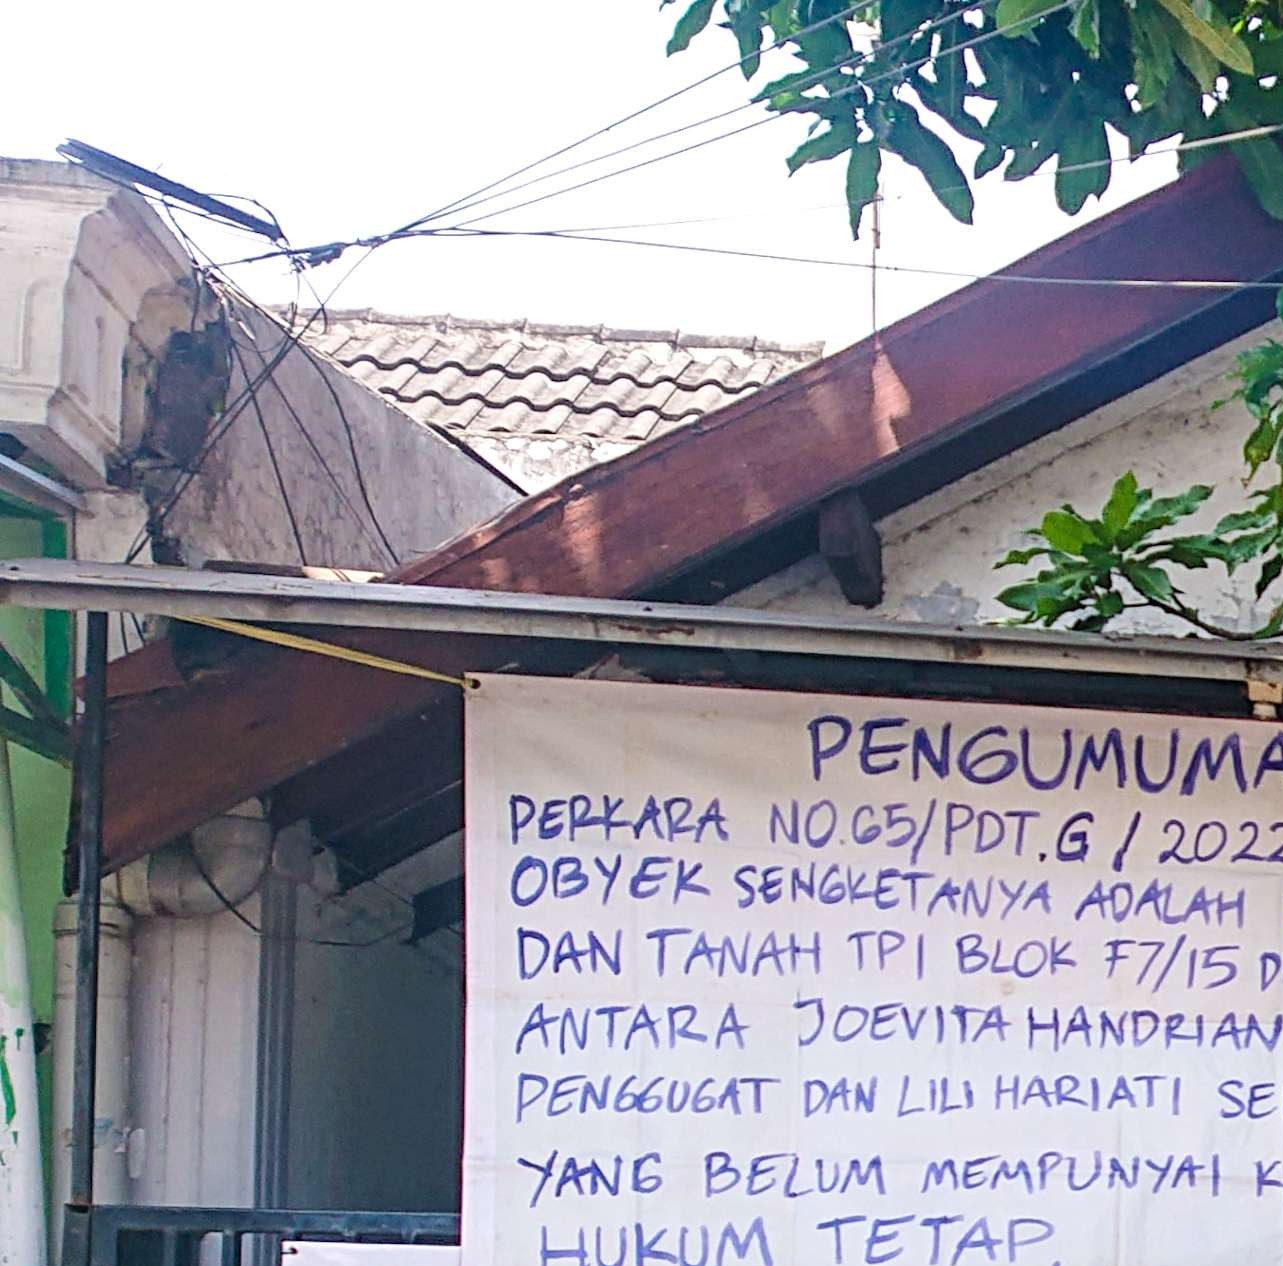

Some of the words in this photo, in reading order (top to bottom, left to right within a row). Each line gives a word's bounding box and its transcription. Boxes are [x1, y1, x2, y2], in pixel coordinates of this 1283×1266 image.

[509, 793, 729, 846] PERKARA
[511, 854, 711, 908] OBYEK
[734, 862, 1053, 919] SENGKETANYA
[1074, 877, 1245, 930] ADALAH
[516, 926, 624, 981] DAN
[646, 926, 821, 978] TANAH
[848, 929, 925, 980] TPI
[955, 933, 1077, 977] BLOK
[1104, 934, 1242, 994] F7/15
[515, 1002, 749, 1055] ANTARA
[794, 998, 1012, 1046] JOEVITA
[516, 1072, 781, 1123] PENGGUGAT
[803, 1076, 880, 1118] DAN
[898, 1074, 975, 1117] LILI
[995, 1073, 1182, 1113] HARIATI
[517, 1150, 664, 1207] YANG
[705, 1152, 886, 1198] BELUM
[921, 1152, 1221, 1197] MEMPUNYAI
